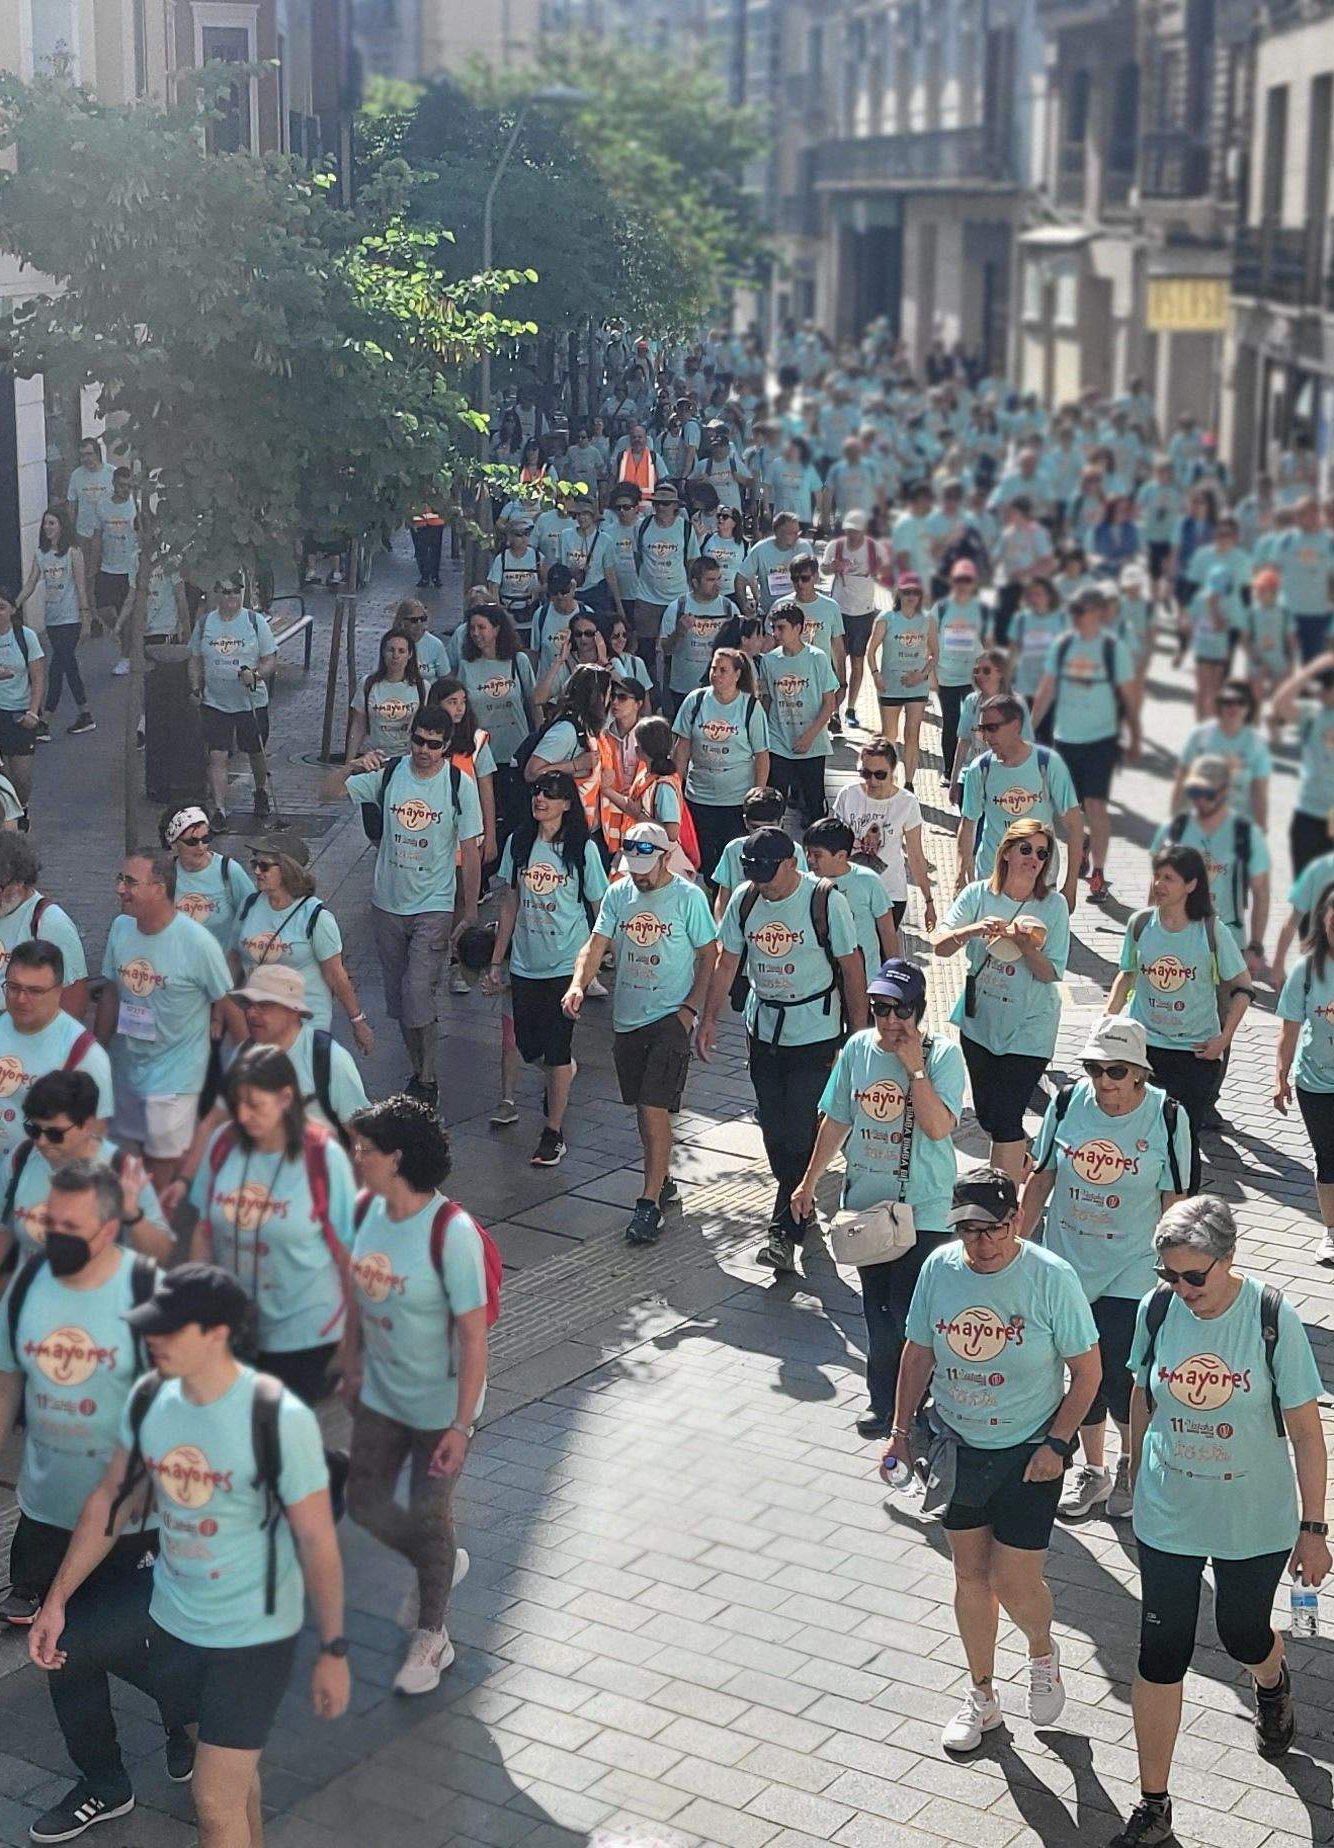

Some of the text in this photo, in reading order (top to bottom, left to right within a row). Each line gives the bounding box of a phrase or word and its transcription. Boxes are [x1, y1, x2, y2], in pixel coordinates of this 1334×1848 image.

[390, 804, 442, 824] +mayores
[176, 902, 220, 917] mayores
[619, 922, 673, 940] +mayores
[748, 931, 804, 949] +mayores
[1140, 965, 1196, 984] +mayores
[854, 1091, 908, 1113] +mayor
[1064, 1146, 1139, 1174] +mayores
[1069, 1188, 1079, 1199] 11
[936, 1322, 1024, 1348] +mayores
[946, 1368, 957, 1380] 11
[1158, 1366, 1251, 1398] +mayores
[1171, 1417, 1184, 1433] 11
